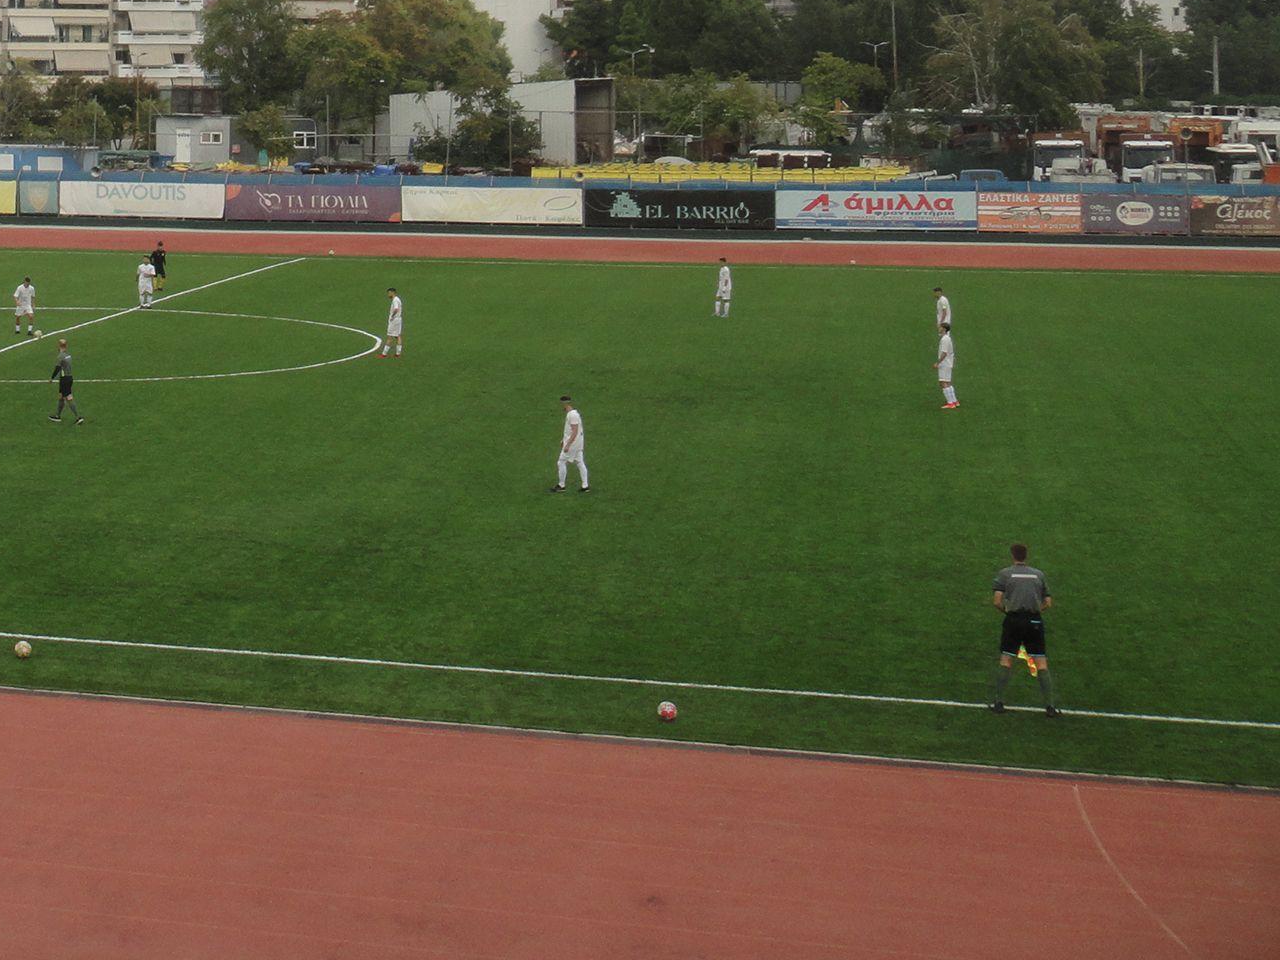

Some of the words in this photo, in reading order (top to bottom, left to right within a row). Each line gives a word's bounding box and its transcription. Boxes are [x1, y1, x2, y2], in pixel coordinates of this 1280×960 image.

[96, 183, 187, 201] DAVOUTIS
[979, 193, 1030, 203] ΕΛΑΣΤΙΚΑ
[1038, 194, 1080, 203] ΖΑΝΤΕΣ
[285, 195, 304, 208] ΤΑ
[843, 193, 954, 215] άμιλλα
[645, 205, 670, 219] EL
